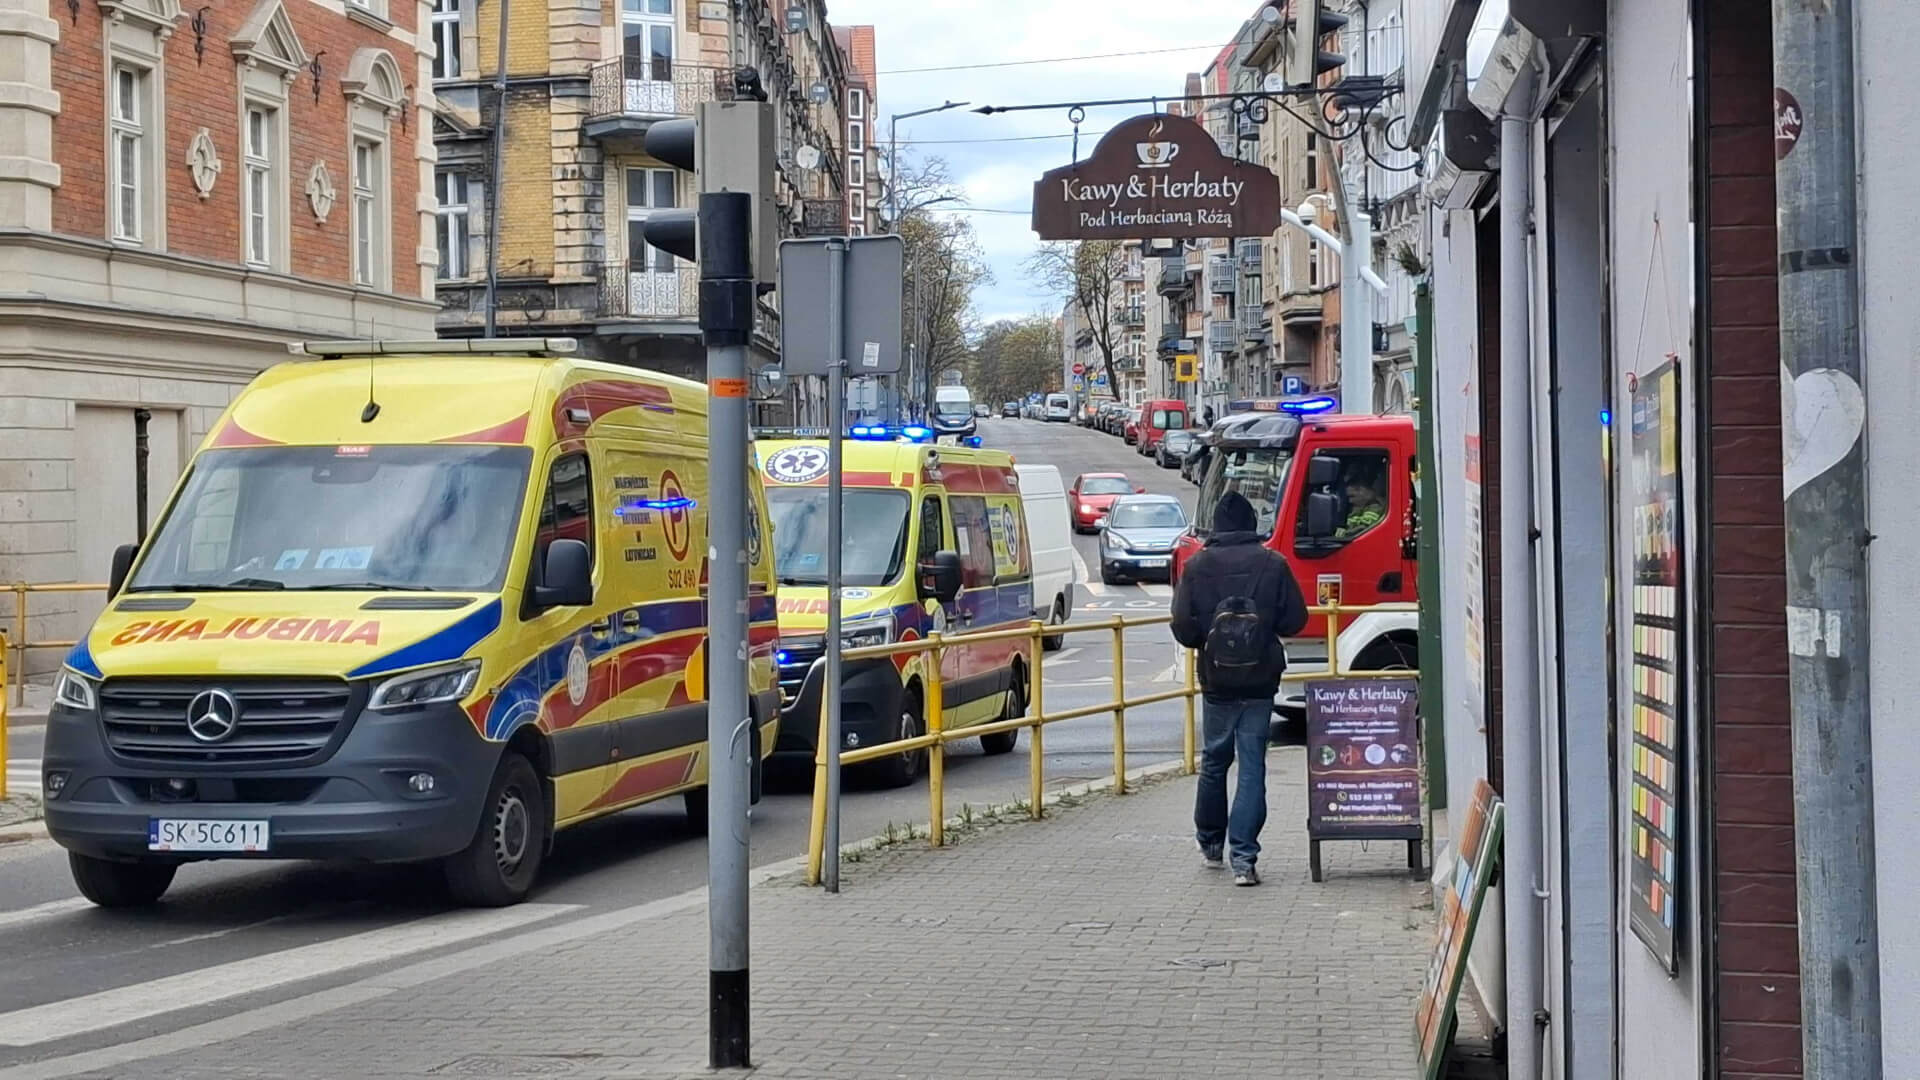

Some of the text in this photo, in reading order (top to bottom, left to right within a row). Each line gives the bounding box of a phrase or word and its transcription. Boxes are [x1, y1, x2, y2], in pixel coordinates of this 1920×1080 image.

[1061, 171, 1244, 207] Kawy & Herbaty
[1080, 207, 1233, 228] Pod Herbacianą Różą
[1287, 378, 1298, 392] P
[1313, 685, 1409, 704] Kawy & Herbaty
[163, 822, 261, 844] SK 5C611
